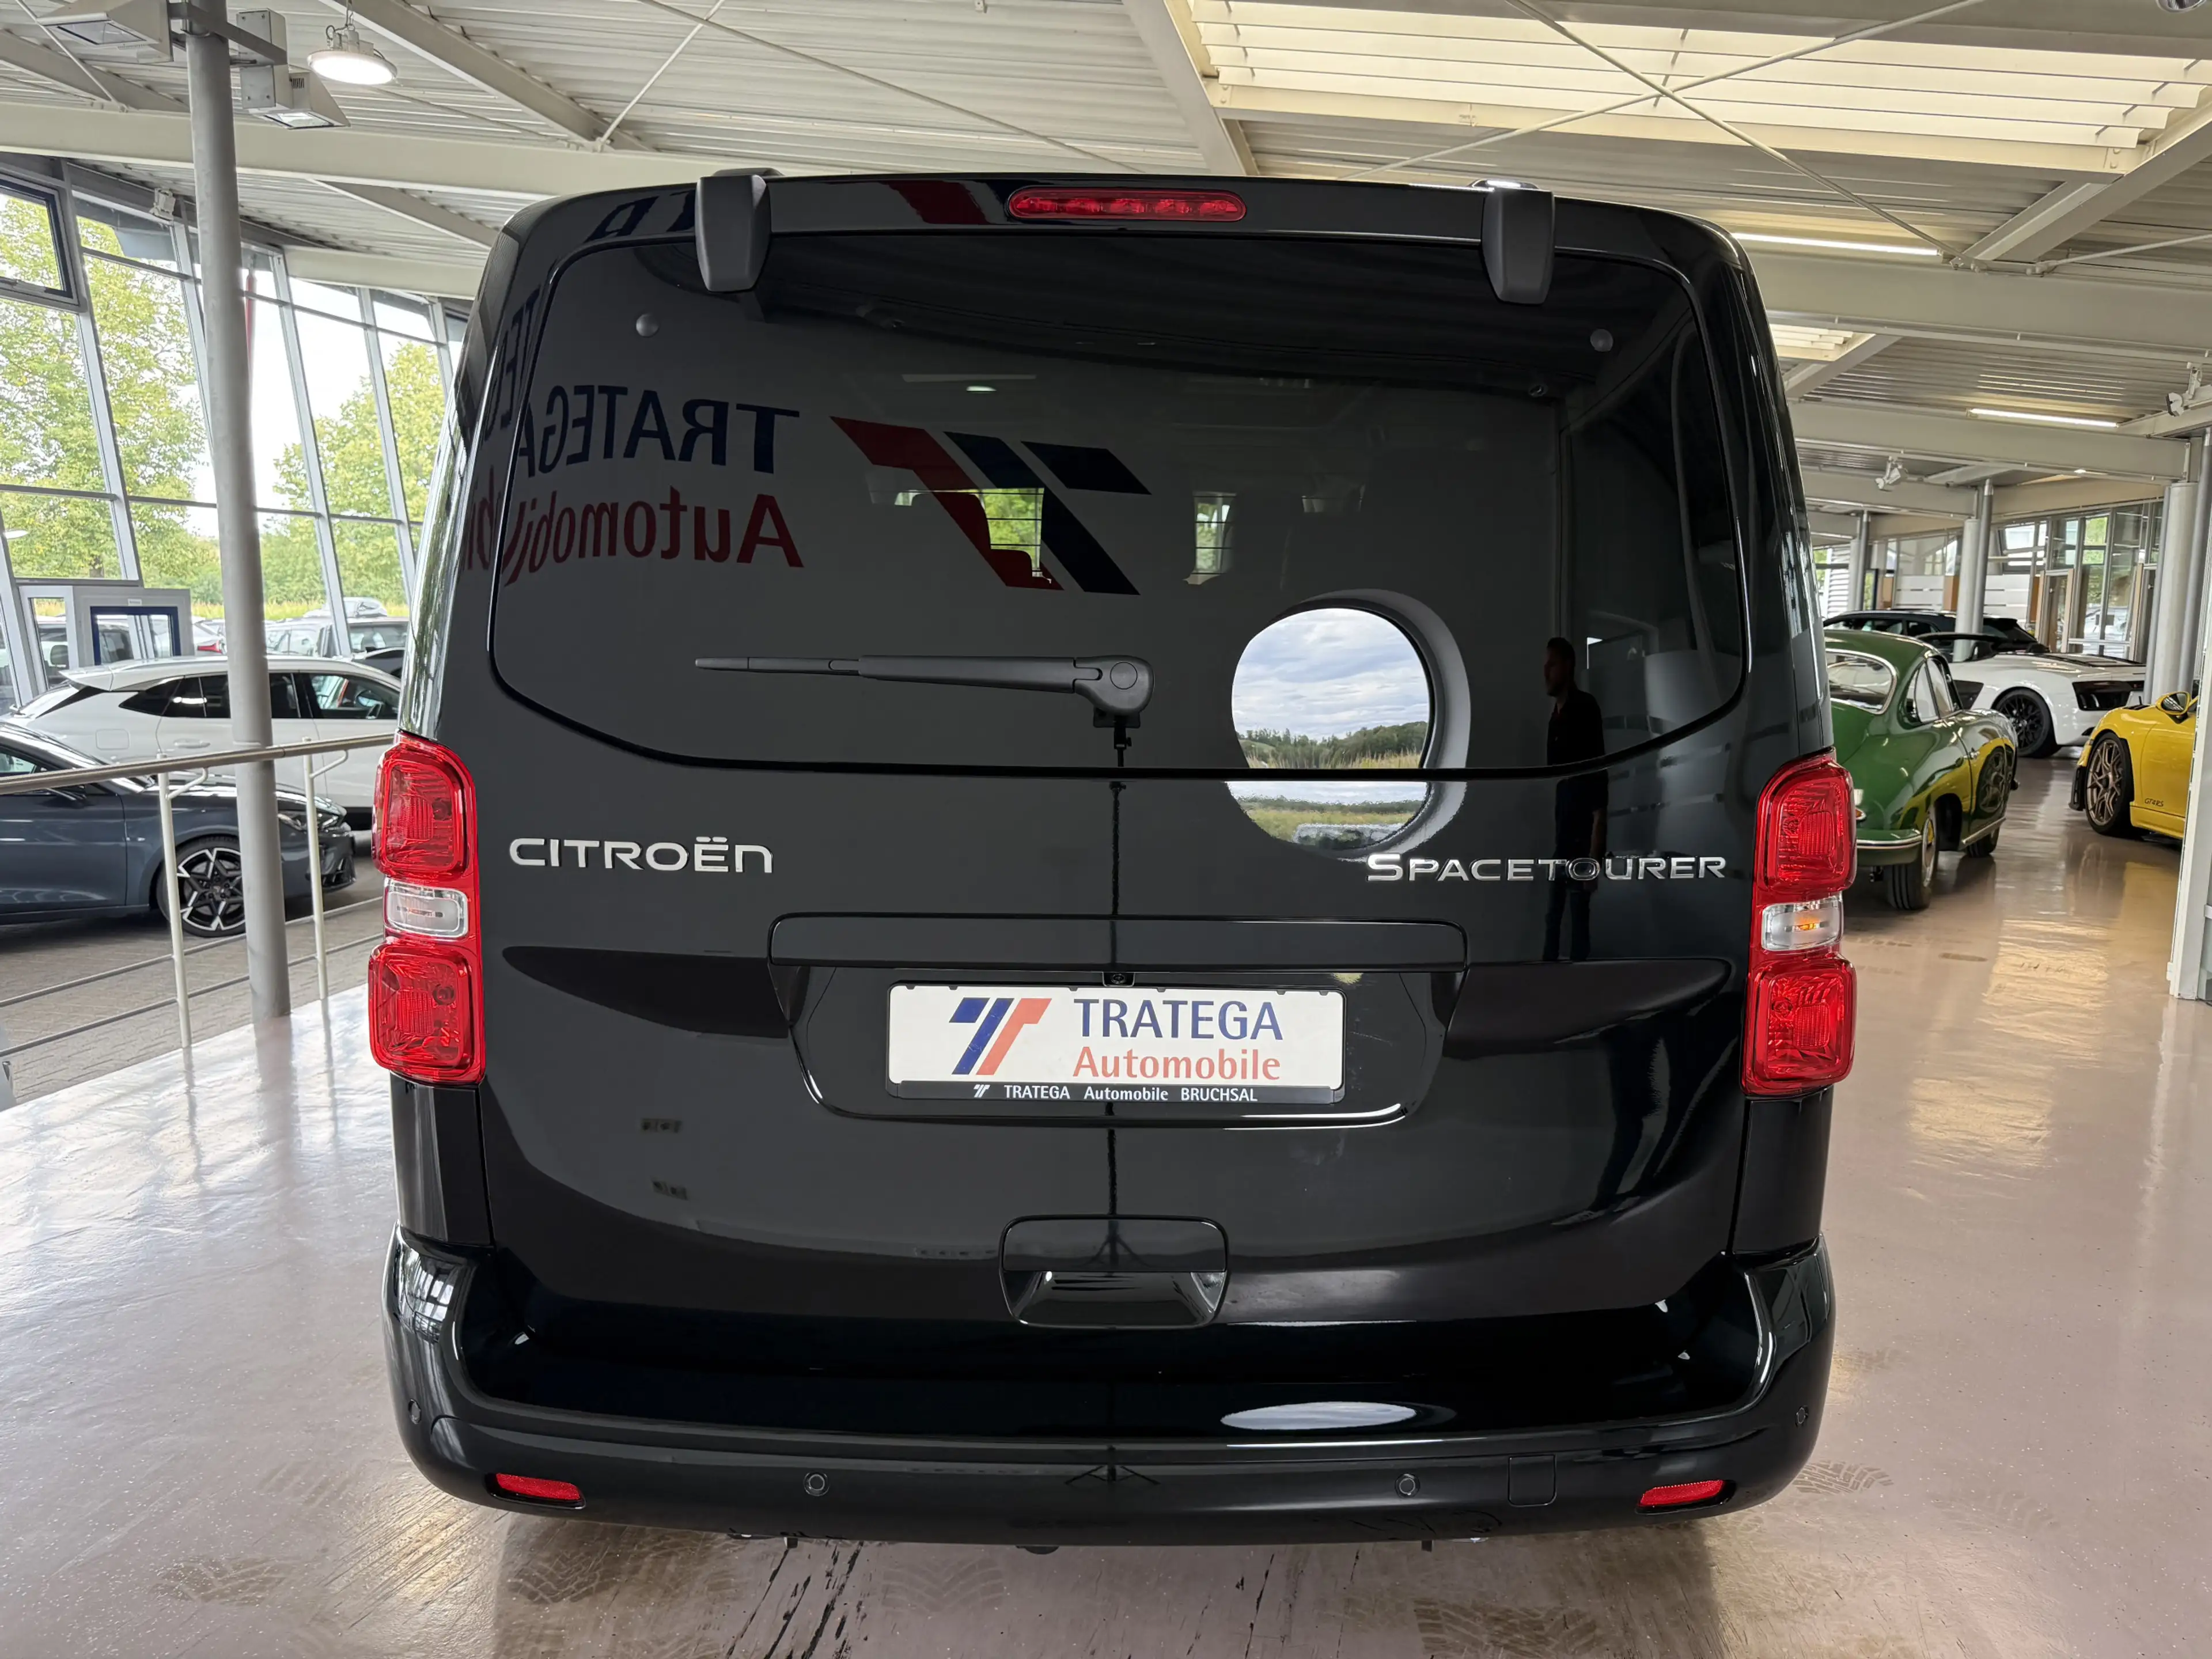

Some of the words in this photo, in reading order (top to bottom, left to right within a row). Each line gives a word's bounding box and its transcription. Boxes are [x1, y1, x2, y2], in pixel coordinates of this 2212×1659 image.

[1073, 998, 1283, 1040] TRATEGA
[1073, 1046, 1281, 1080] Automobile
[1003, 1085, 1070, 1100] TRATEGA
[1084, 1086, 1168, 1101] Automobile
[1181, 1088, 1258, 1102] BRUCHSAL
